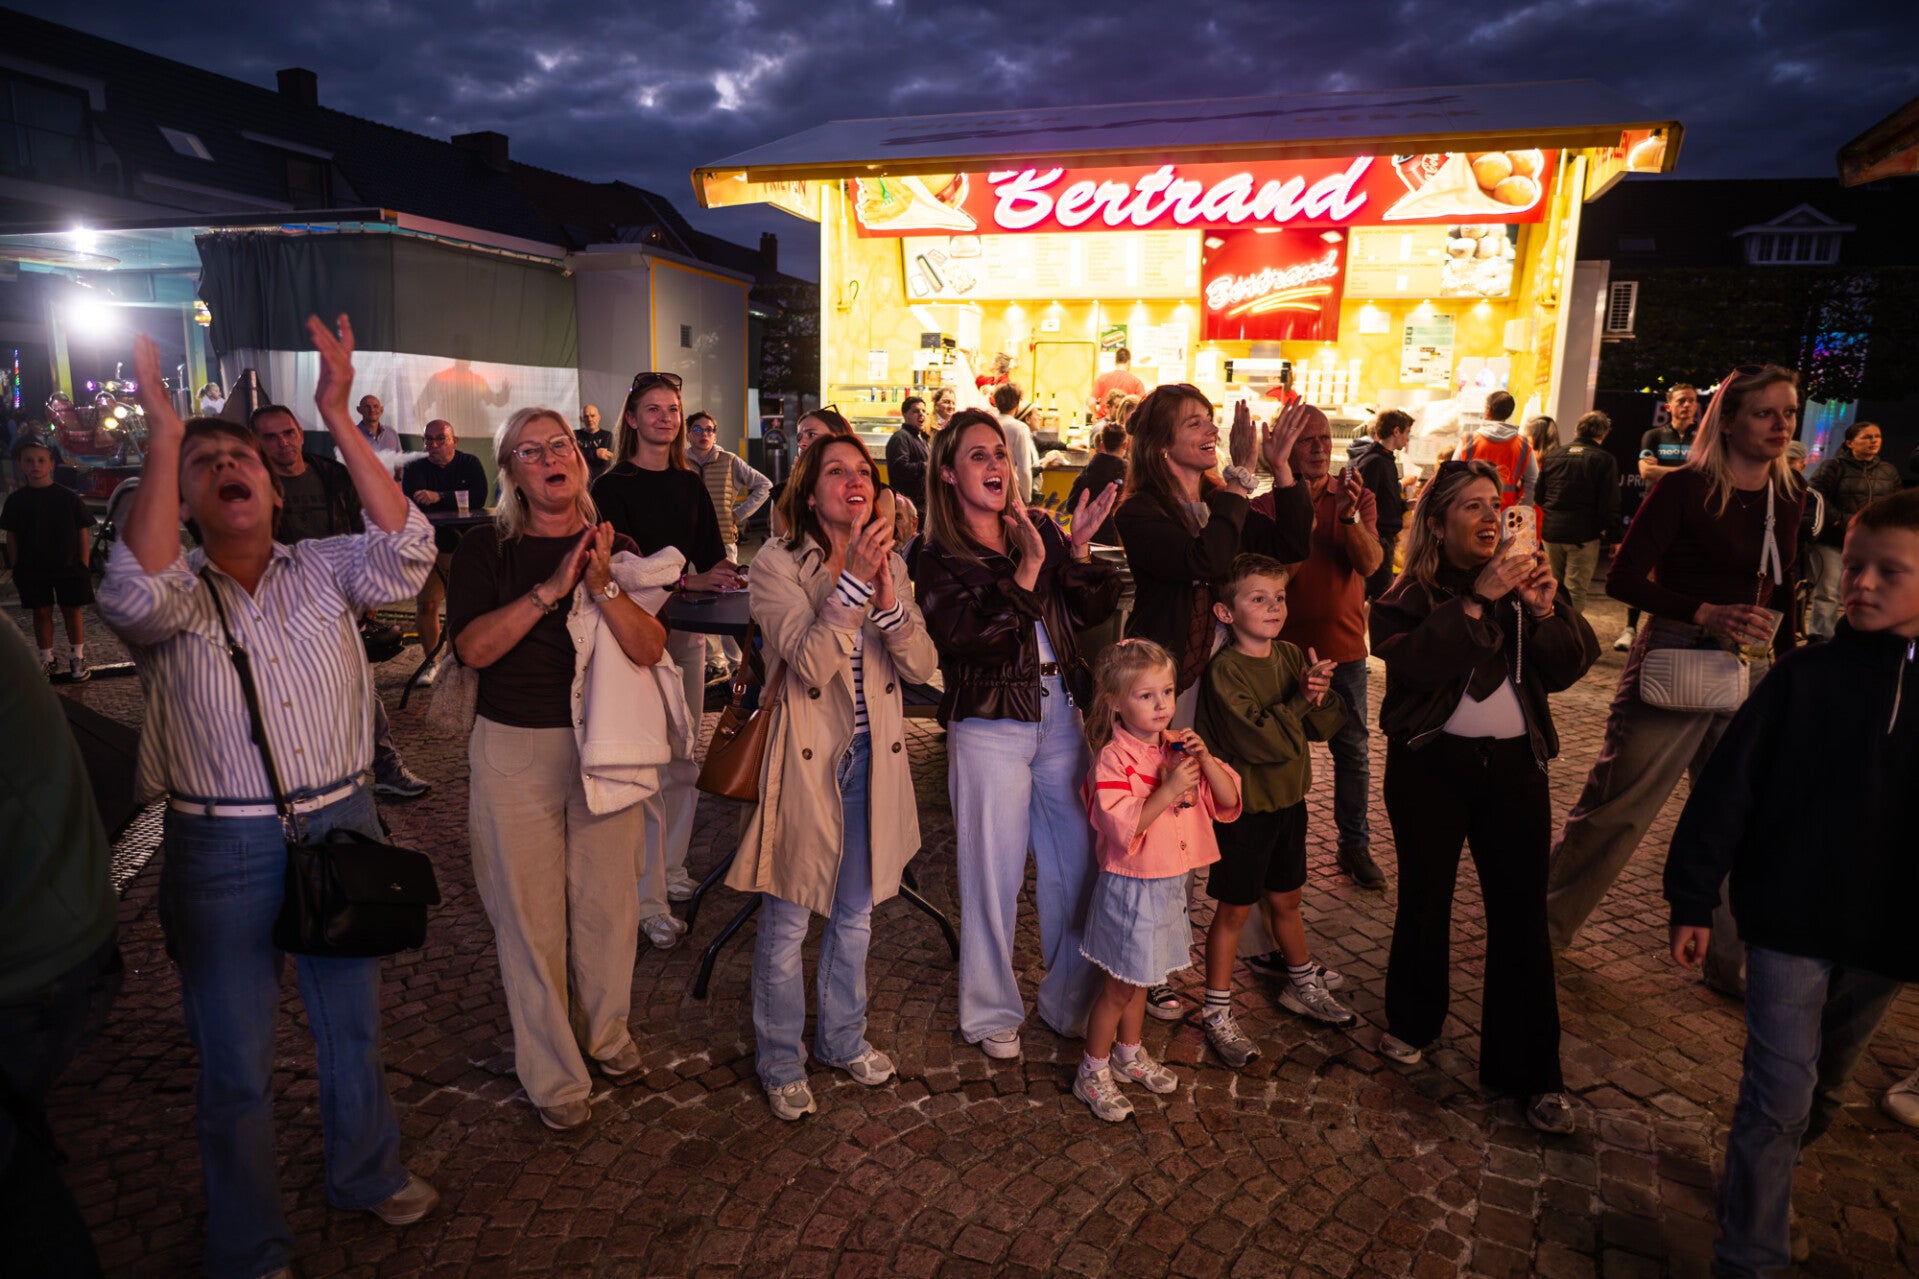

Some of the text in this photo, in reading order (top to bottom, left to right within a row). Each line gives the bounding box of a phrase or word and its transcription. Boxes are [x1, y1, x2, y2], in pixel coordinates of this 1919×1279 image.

[988, 158, 1374, 229] Bertrand
[1205, 249, 1338, 310] Bertrand
[1657, 448, 1692, 456] moov
